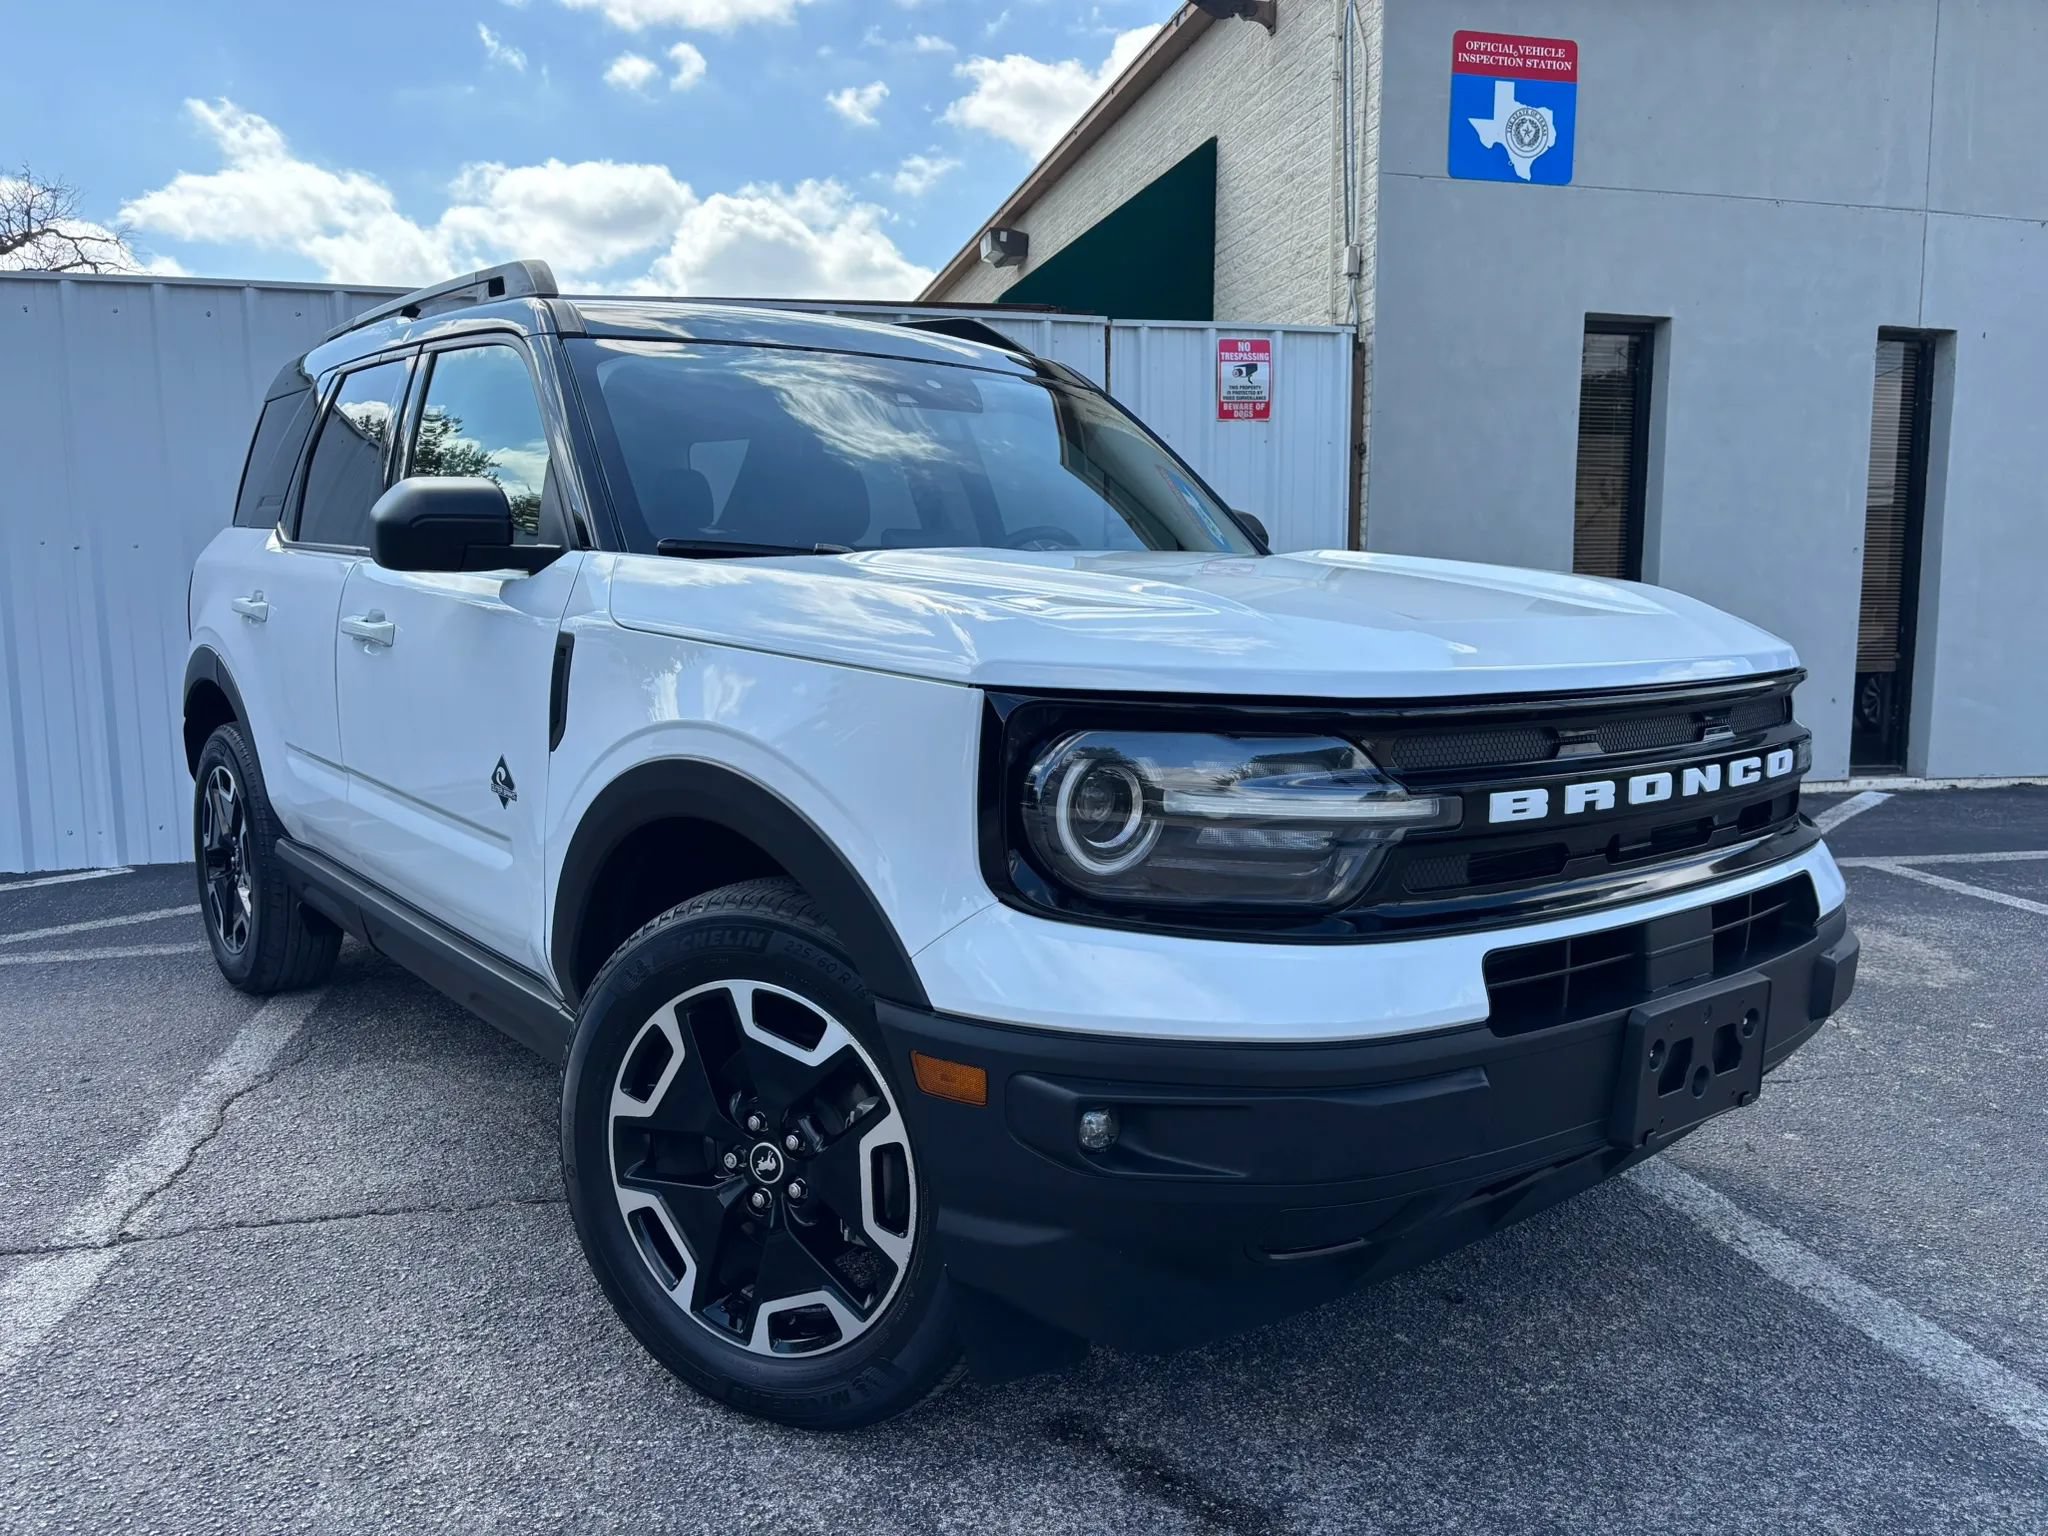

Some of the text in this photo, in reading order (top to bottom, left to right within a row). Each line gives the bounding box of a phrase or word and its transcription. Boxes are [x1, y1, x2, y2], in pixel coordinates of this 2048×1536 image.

[1465, 40, 1566, 58] OFFICIAL VEHICLE
[1458, 53, 1572, 71] INSPECTION STATION
[1237, 341, 1251, 352] NO
[1220, 352, 1270, 361] TRESPASSING
[1223, 402, 1266, 411] BEWARE OF
[1233, 410, 1254, 418] DOGS
[1488, 748, 1794, 824] BRONCO
[784, 940, 838, 973] 225/60
[838, 971, 852, 985] R
